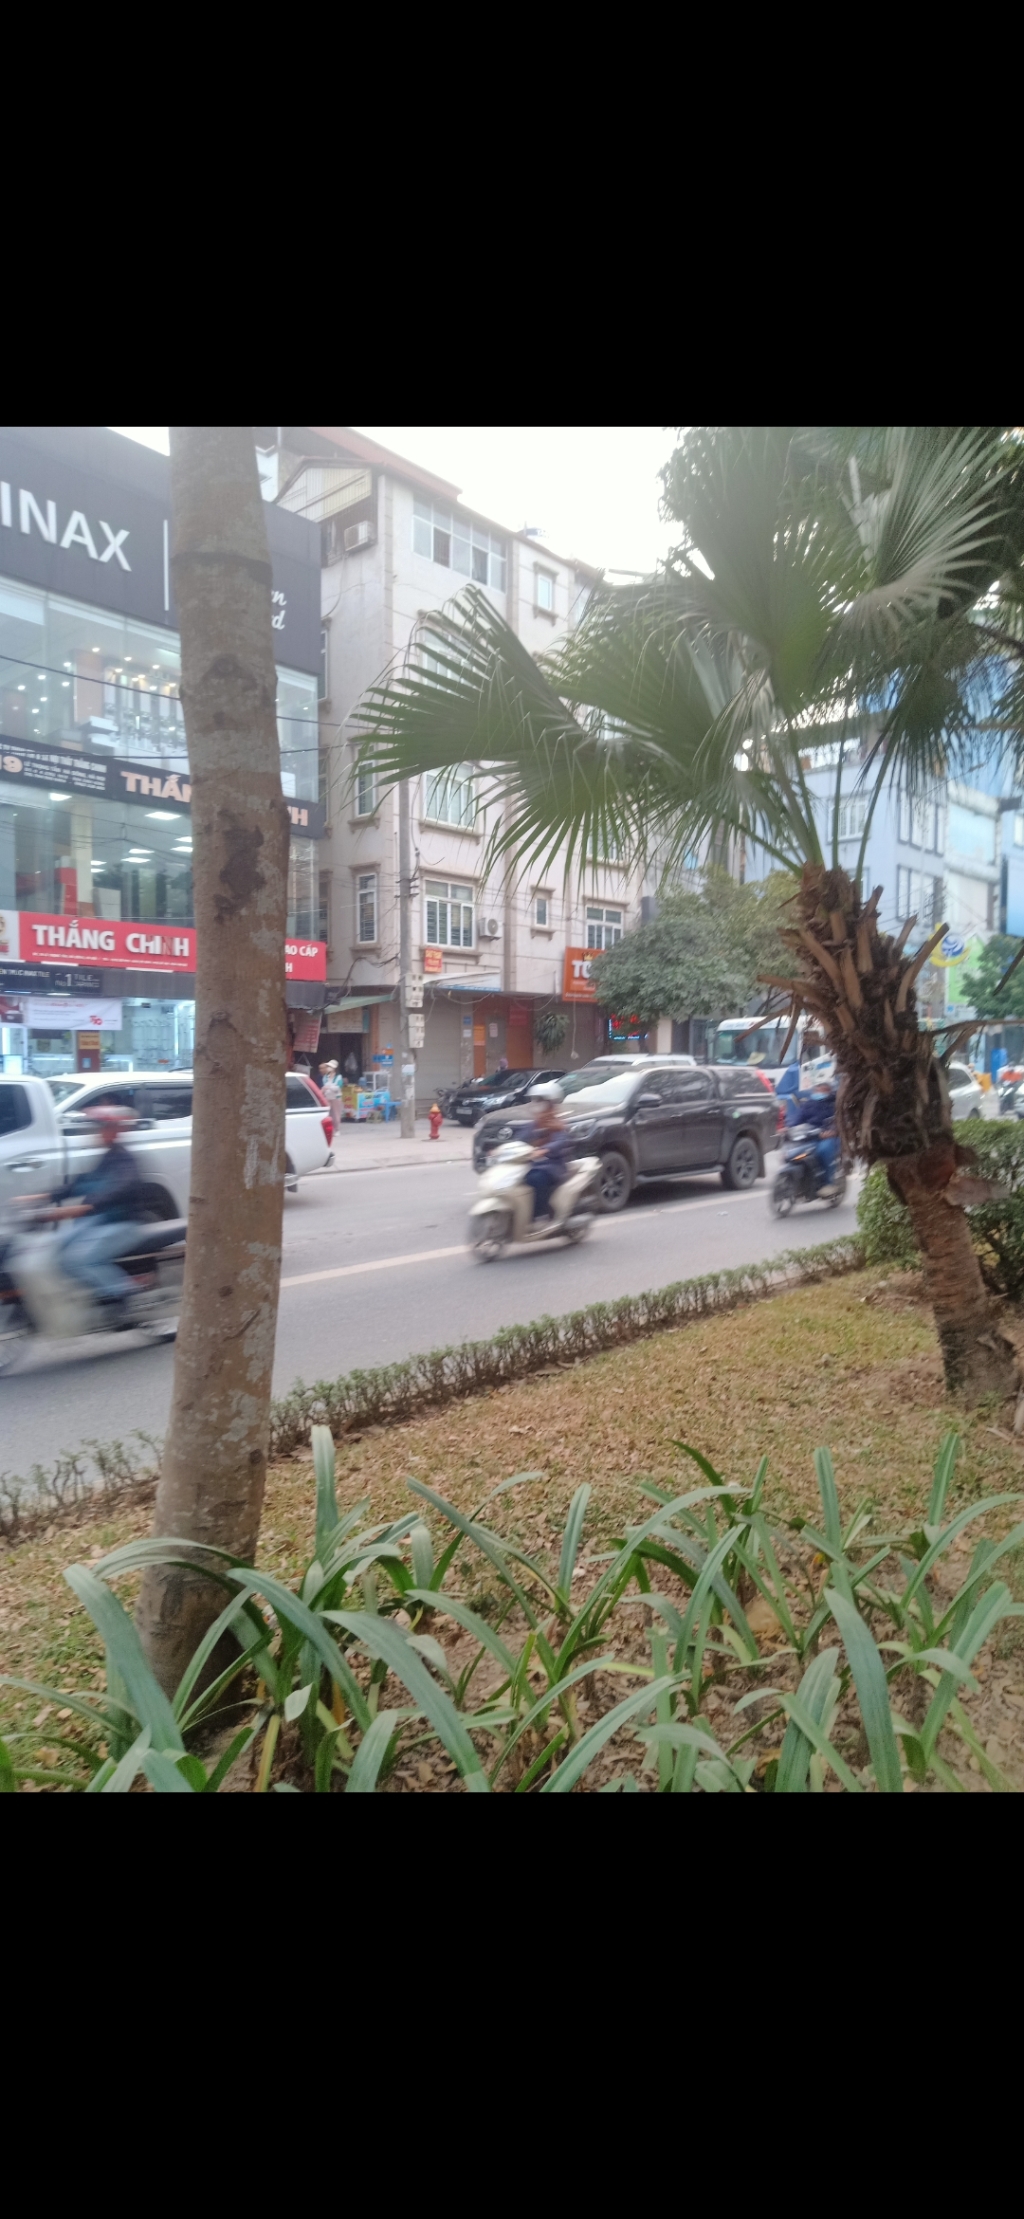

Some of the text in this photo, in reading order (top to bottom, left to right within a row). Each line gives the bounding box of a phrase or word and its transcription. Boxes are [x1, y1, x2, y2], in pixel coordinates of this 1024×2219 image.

[0, 481, 132, 572] INAX
[32, 919, 115, 951] THẮNG
[299, 943, 318, 957] CẤP
